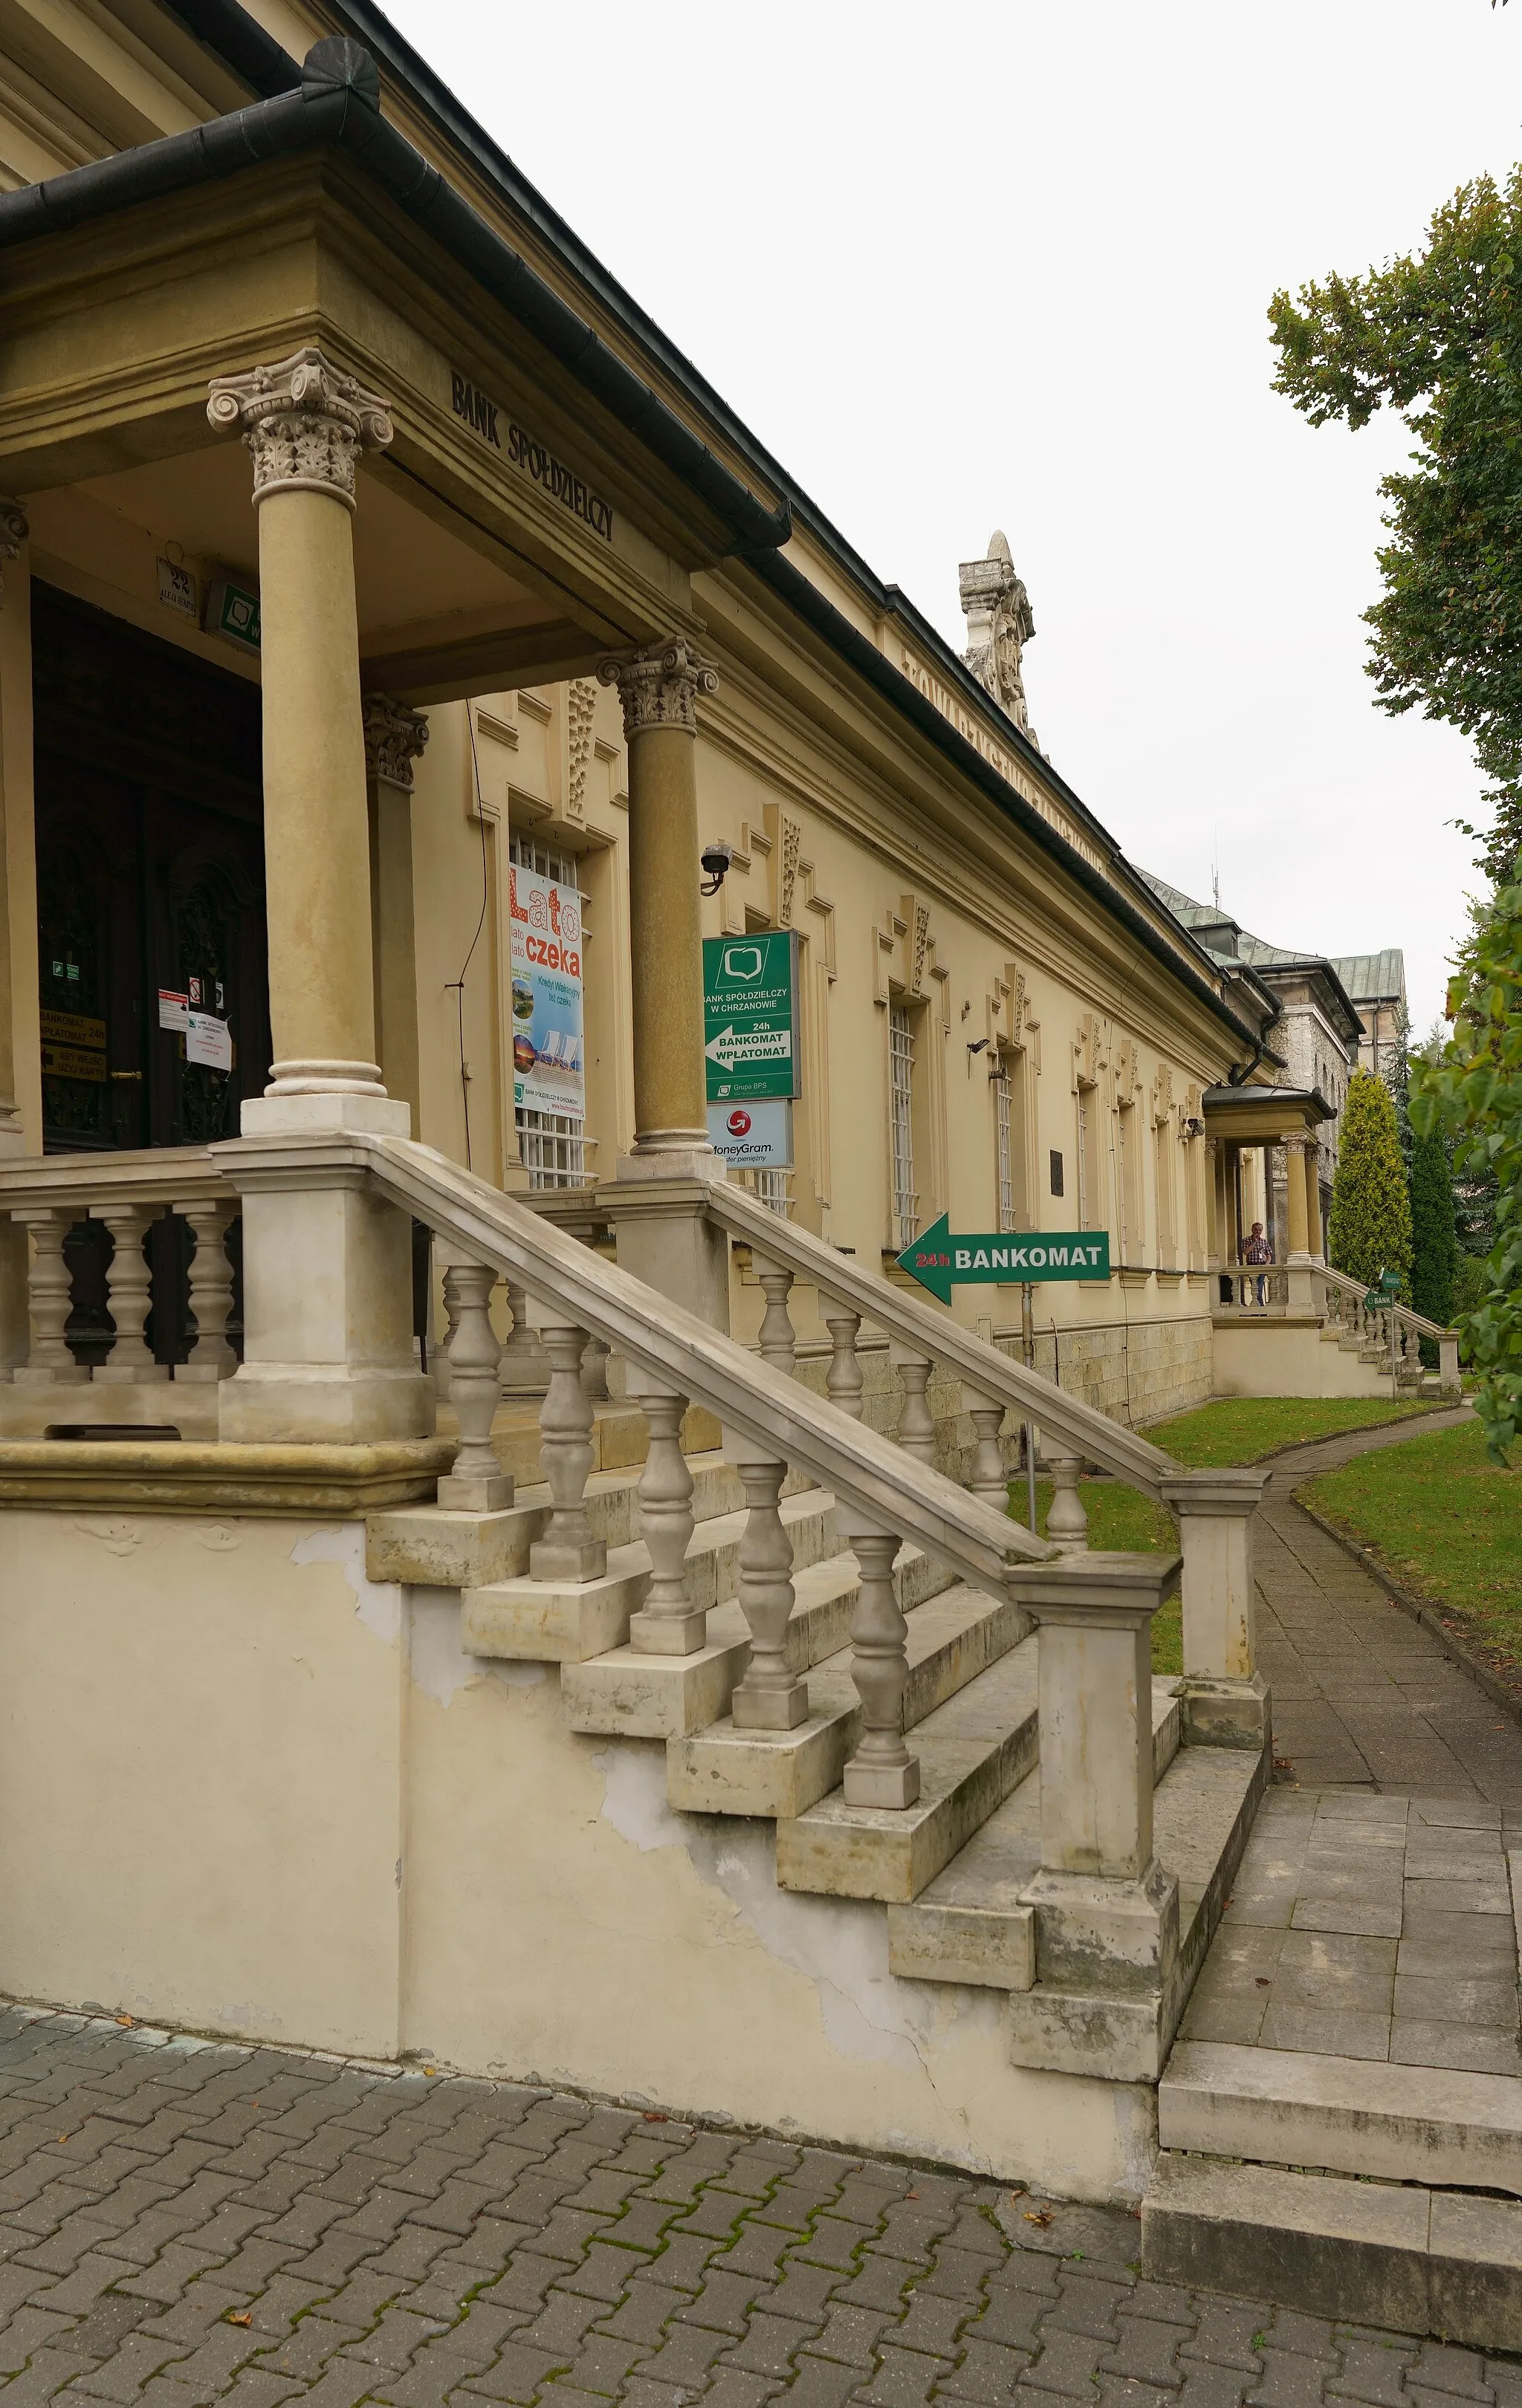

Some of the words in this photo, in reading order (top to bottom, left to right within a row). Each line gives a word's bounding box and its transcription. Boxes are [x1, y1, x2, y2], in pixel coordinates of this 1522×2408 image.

[451, 370, 502, 450] BANK
[170, 567, 190, 595] 22
[161, 588, 177, 603] ALEJA
[509, 868, 580, 942] Lato
[511, 925, 524, 940] lato
[511, 943, 525, 958] lato
[525, 935, 580, 978] czeka
[538, 976, 554, 991] Kredyt
[554, 981, 580, 1000] Wakacyjny
[725, 989, 787, 1002] SPÓŁDZIELCZY
[557, 998, 571, 1007] czeka
[721, 1000, 777, 1012] CHRZANOWIE
[753, 1022, 770, 1031] 24h
[88, 1028, 105, 1039] 24h
[719, 1033, 783, 1046] BANKOMAT
[716, 1047, 787, 1060] WPŁATOMAT
[734, 1084, 752, 1092] Grupa
[737, 1155, 767, 1164] pieniężny
[916, 1253, 950, 1268] 24h
[955, 1247, 1102, 1269] BANKOMAT
[1374, 1297, 1390, 1305] BANK
